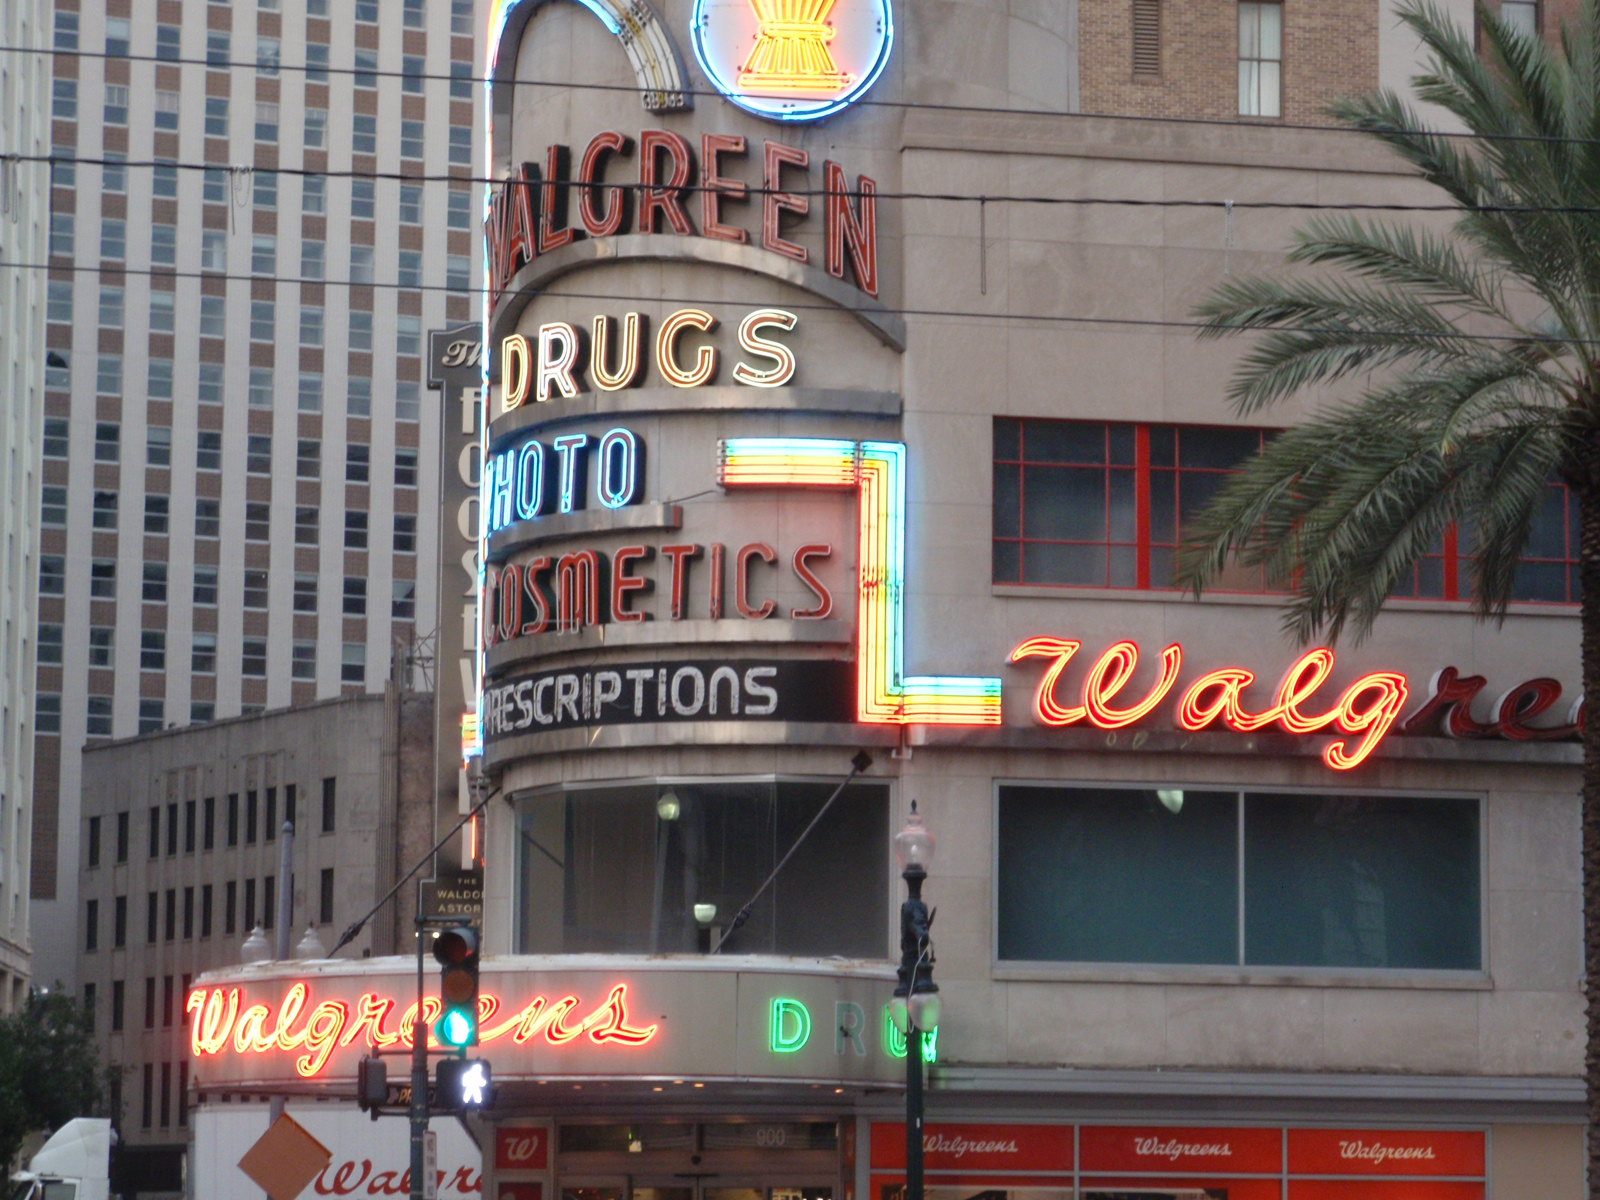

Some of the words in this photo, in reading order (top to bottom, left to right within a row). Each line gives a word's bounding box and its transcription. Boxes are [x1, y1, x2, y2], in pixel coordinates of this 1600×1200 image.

[502, 309, 797, 413] DRUGS
[485, 544, 833, 647] COSMETICS
[1006, 636, 1588, 770] Walgre
[757, 1128, 785, 1146] 900
[923, 1134, 1018, 1158] Walgreens
[1134, 1137, 1232, 1161] Walgreens
[1339, 1141, 1436, 1164] Walgreens
